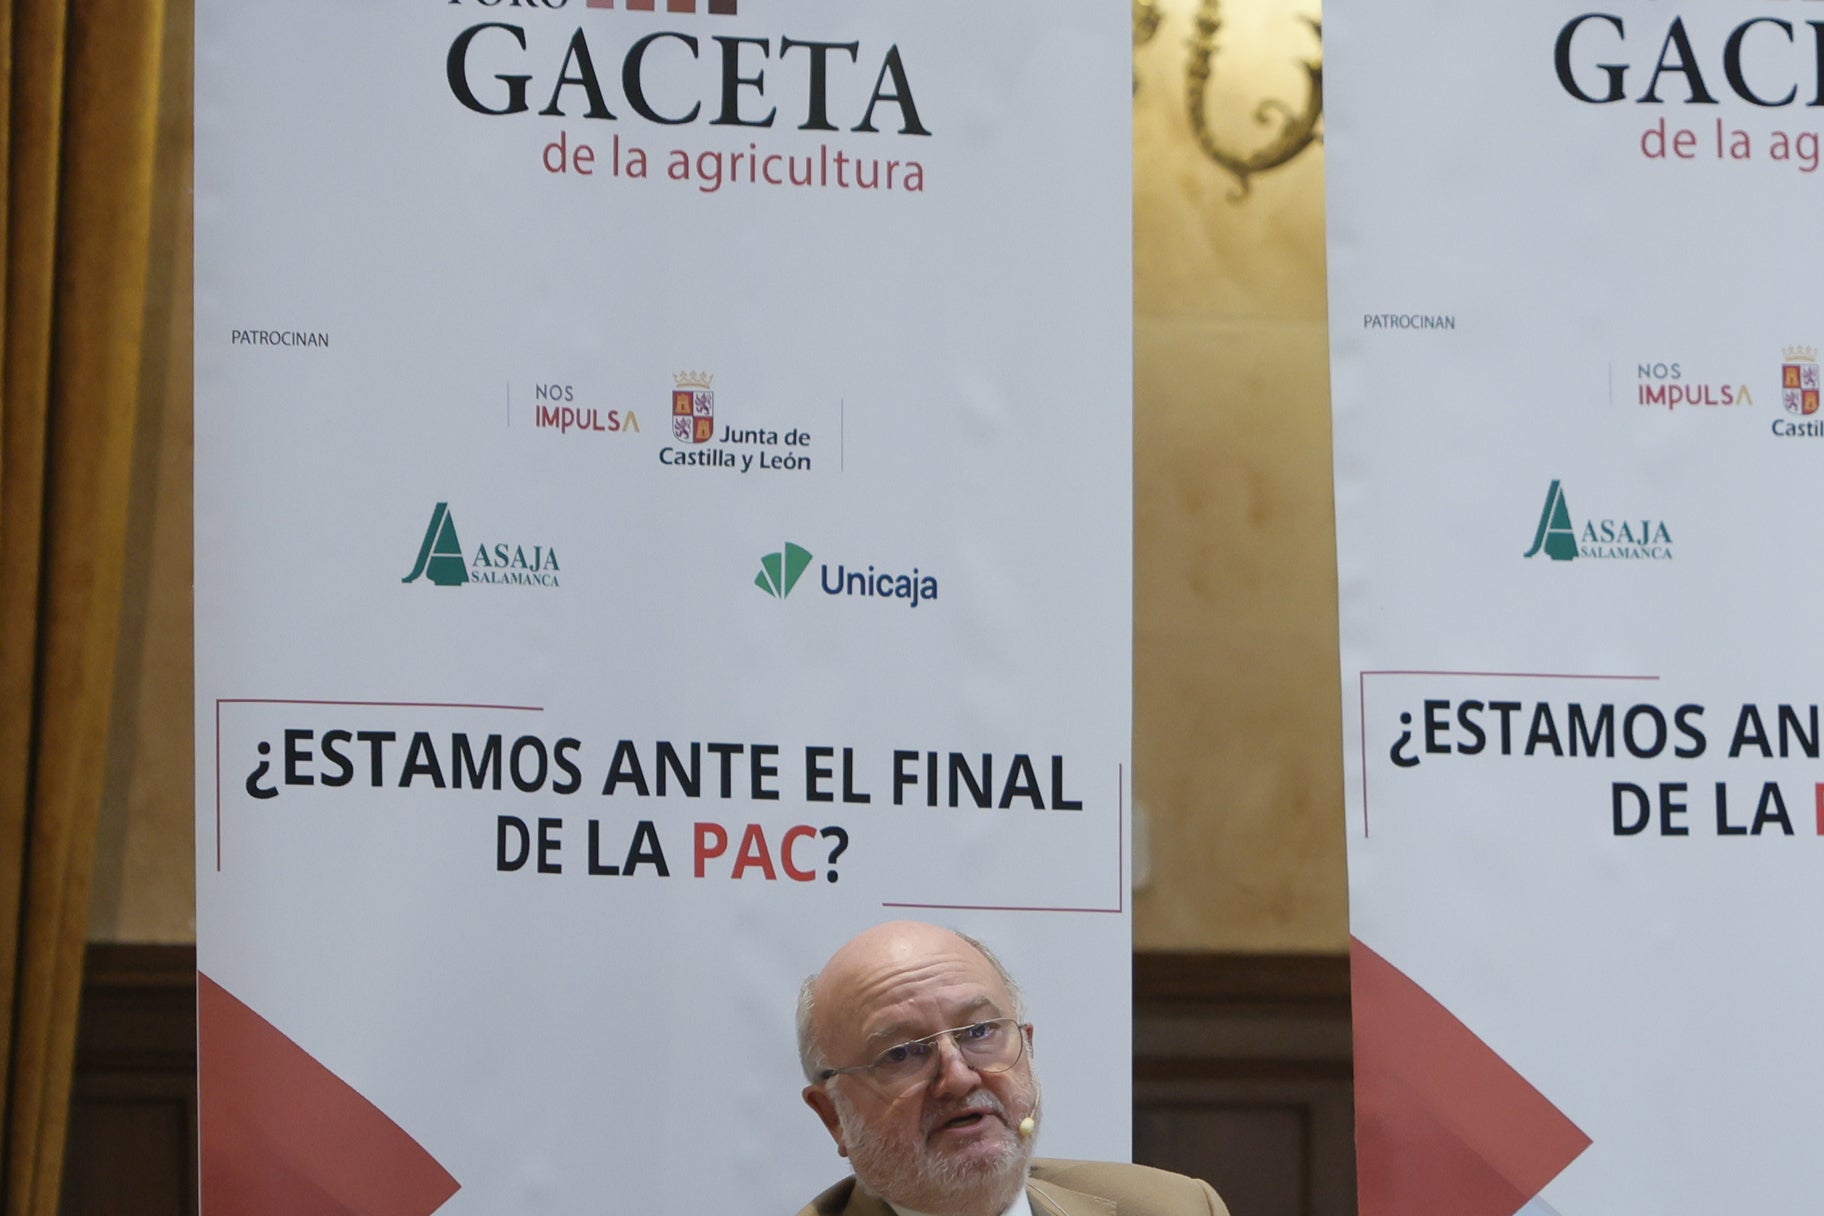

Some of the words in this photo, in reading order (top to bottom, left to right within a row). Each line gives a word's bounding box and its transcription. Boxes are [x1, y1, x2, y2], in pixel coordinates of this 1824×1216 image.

[447, 22, 932, 136] GACETA
[1641, 117, 1696, 159] de
[1717, 118, 1750, 159] la
[543, 131, 594, 175] de
[613, 134, 646, 178] la
[668, 143, 923, 193] agricultura
[1364, 314, 1455, 329] PATROCINAN
[232, 330, 328, 347] PATROCINAN
[1638, 363, 1681, 380] NOS
[536, 384, 573, 402] NOS
[720, 426, 777, 445] Junta
[785, 429, 810, 446] de
[659, 447, 735, 467] Castilla
[741, 454, 753, 473] y
[760, 451, 810, 470] León
[1582, 520, 1672, 545] ASAJA
[473, 544, 560, 571] ASAJA
[1581, 543, 1672, 559] SALAMANCA
[471, 569, 560, 587] SALAMANCA
[822, 565, 937, 608] Unicaja
[1390, 700, 1706, 768] ¿ESTAMOS
[246, 729, 581, 799] ¿ESTAMOS
[602, 740, 779, 800] ANTE
[806, 746, 870, 804] EL
[893, 750, 1082, 811] FINAL
[1612, 782, 1689, 836] DE
[1715, 782, 1794, 836] LA
[497, 815, 562, 874] DE
[588, 820, 670, 877] LA
[694, 823, 848, 883] PAC?
